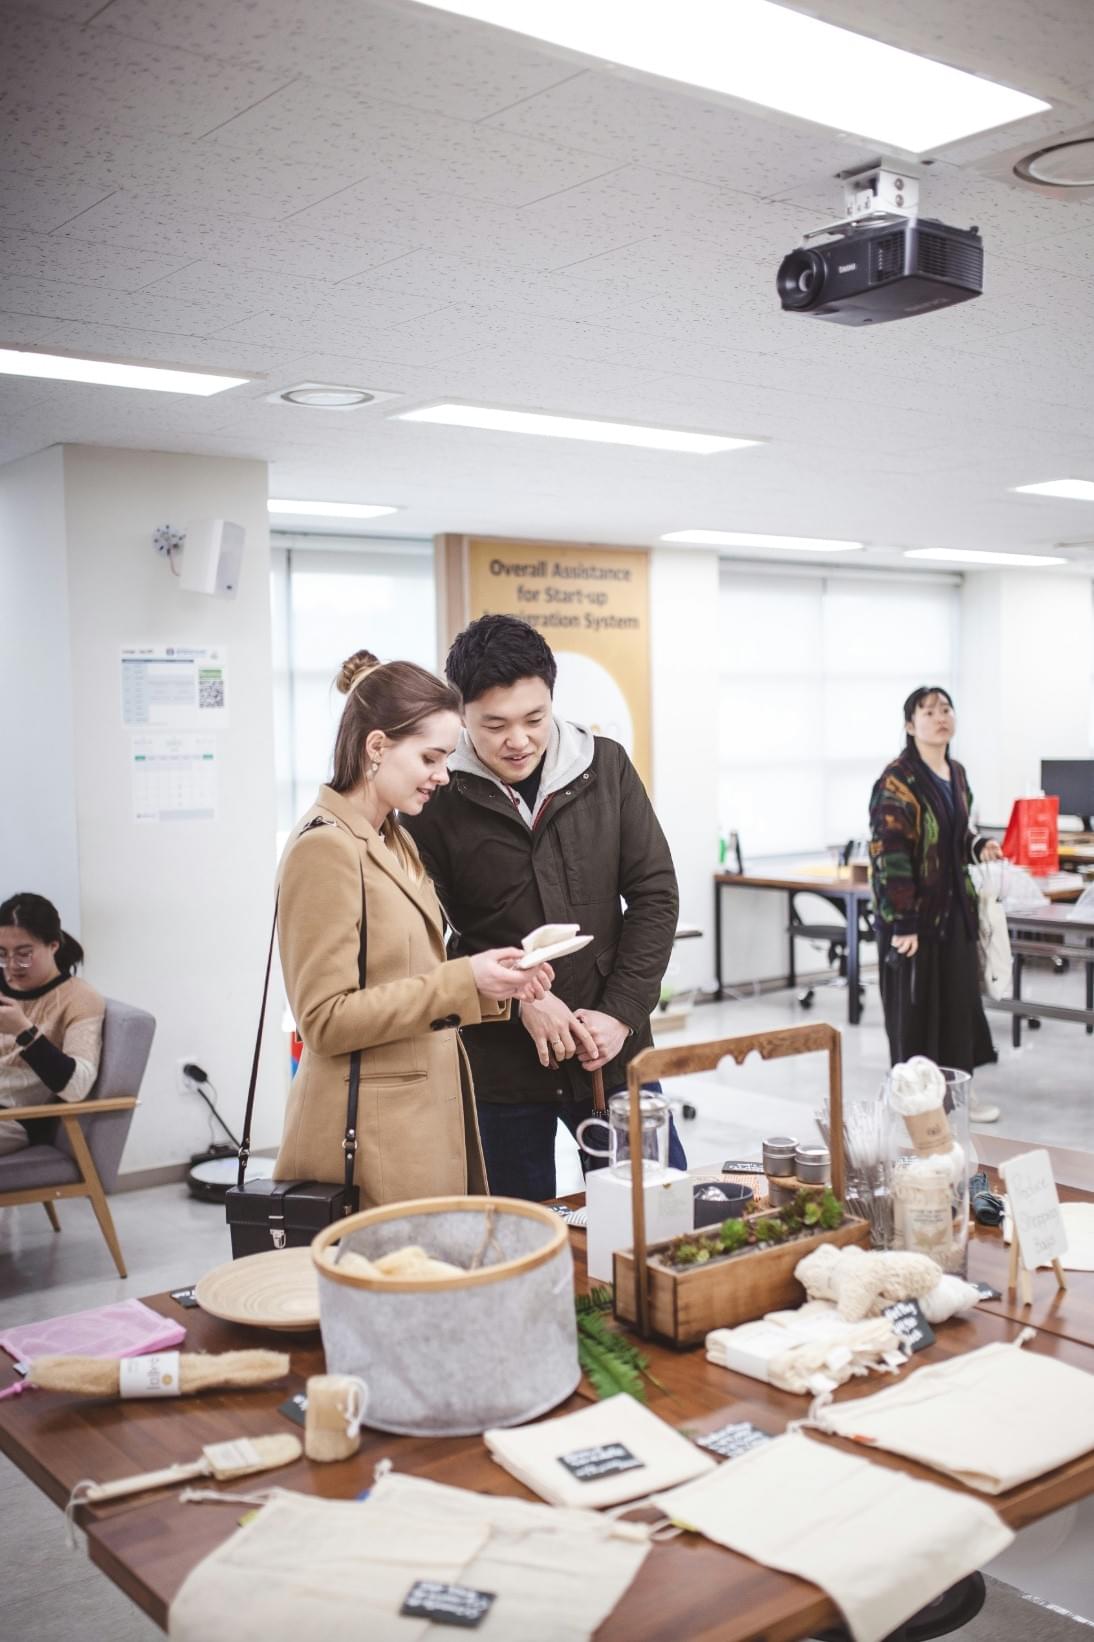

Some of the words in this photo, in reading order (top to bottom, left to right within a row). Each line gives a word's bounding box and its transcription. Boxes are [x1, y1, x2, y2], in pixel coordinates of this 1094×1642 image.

[489, 559, 548, 577] Overall
[552, 562, 632, 581] Assistance
[517, 585, 540, 602] for
[544, 587, 609, 605] Start-up
[585, 613, 640, 631] System
